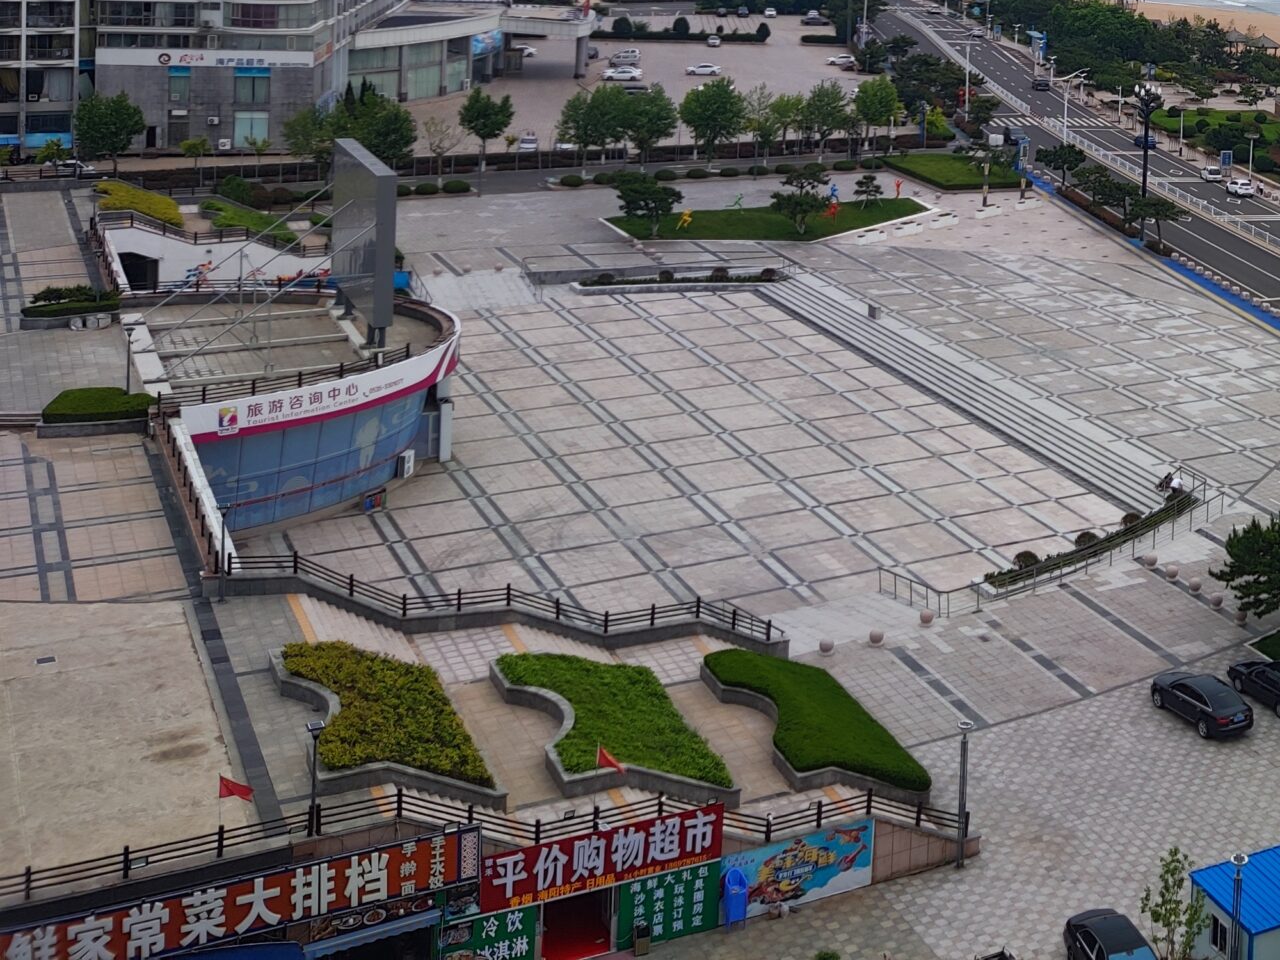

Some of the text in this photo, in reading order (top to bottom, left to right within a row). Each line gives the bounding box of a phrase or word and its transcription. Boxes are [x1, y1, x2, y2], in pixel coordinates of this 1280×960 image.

[246, 396, 360, 426] Tourist Information Center
[247, 383, 359, 419] 旅游咨询中心
[400, 842, 417, 897] 手擀面
[429, 836, 446, 889] 手工水饺
[493, 811, 717, 898] 平价购物超市
[509, 894, 534, 908] 香烟
[586, 873, 616, 890] 日用品
[630, 866, 709, 894] 海鲜大礼包
[634, 879, 705, 905] 沙滩玩具
[481, 910, 524, 939] 冷饮
